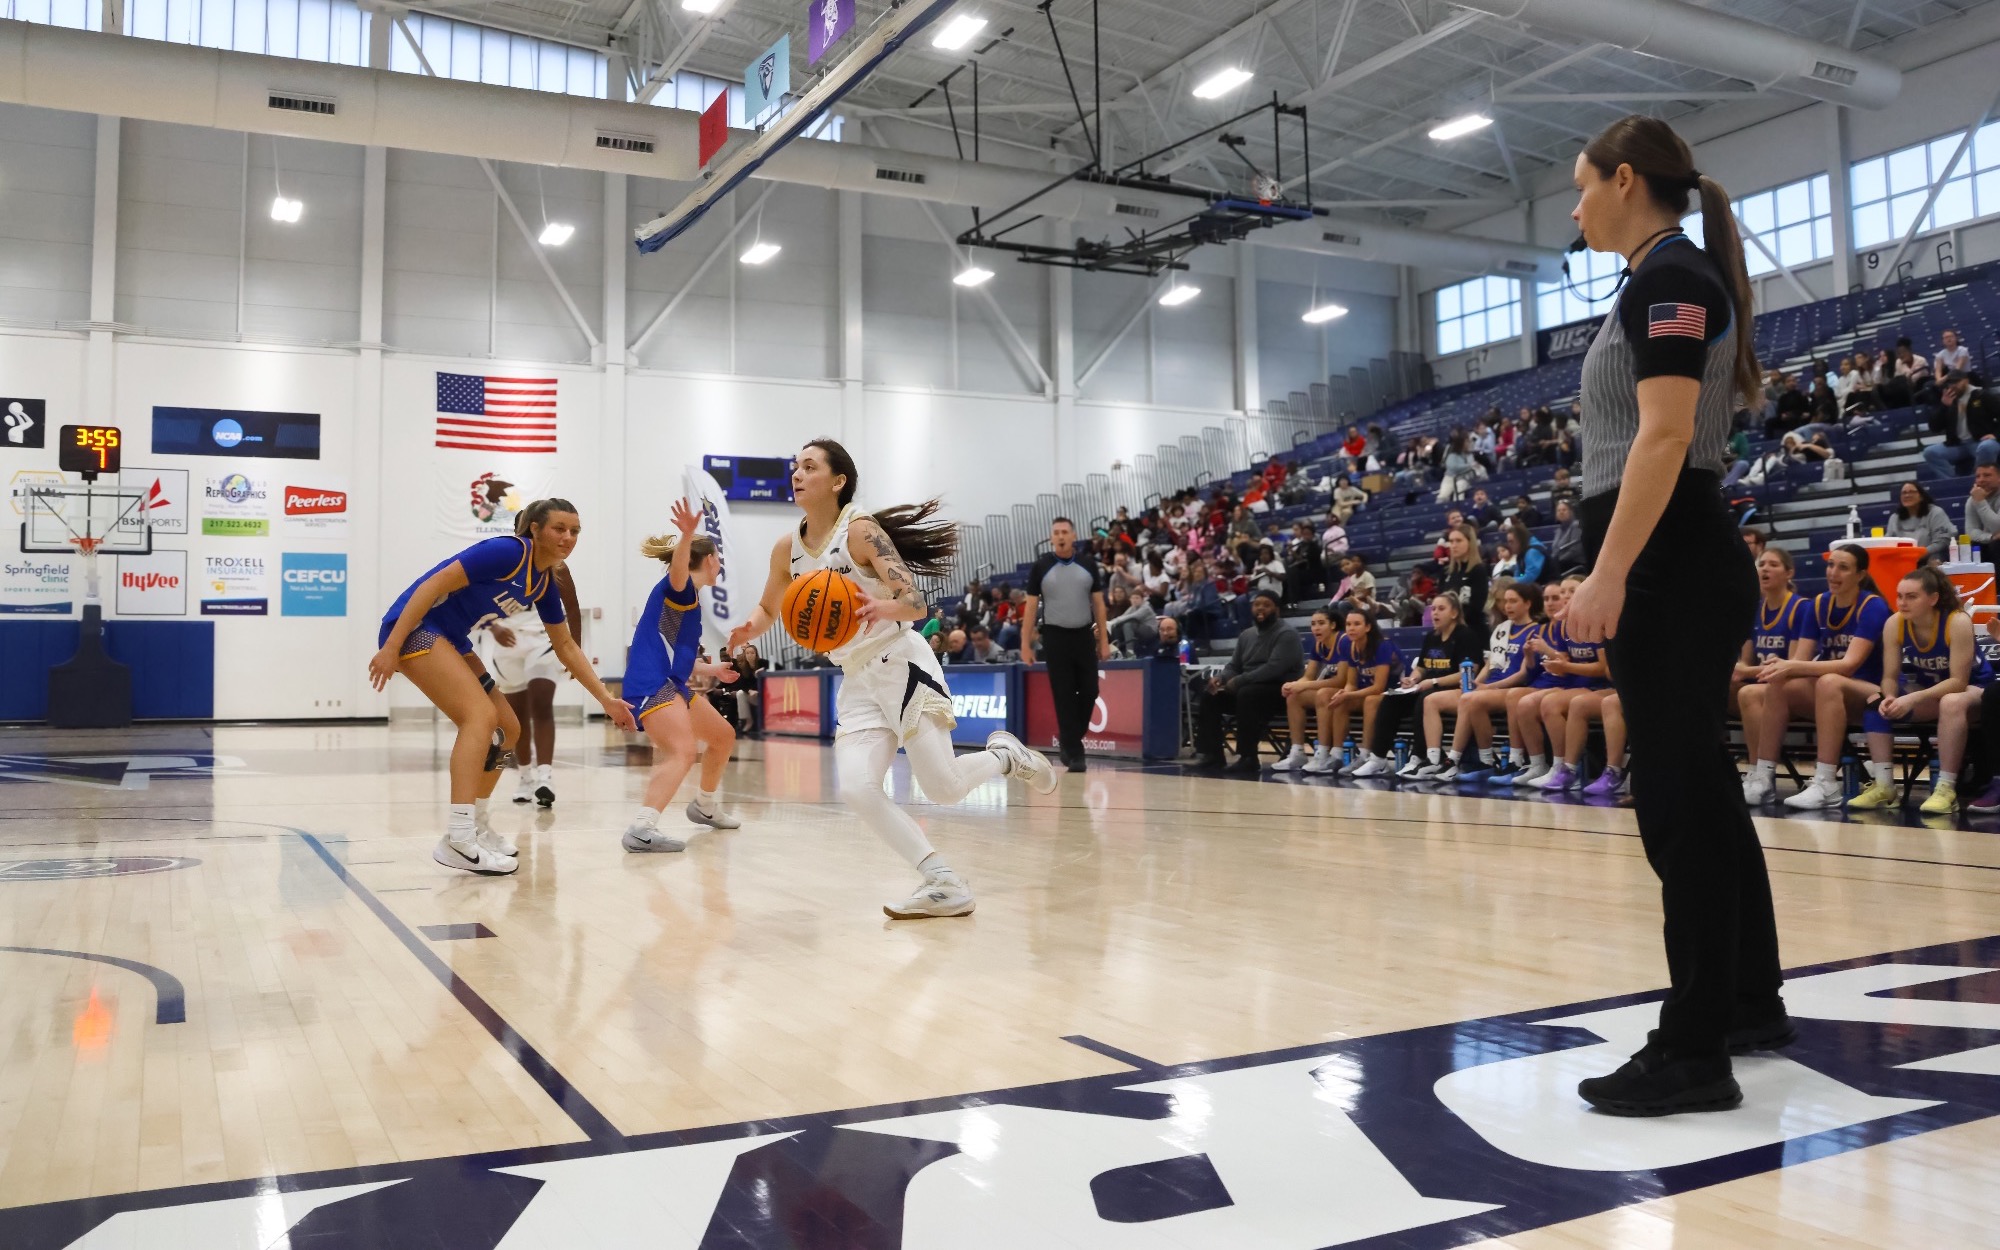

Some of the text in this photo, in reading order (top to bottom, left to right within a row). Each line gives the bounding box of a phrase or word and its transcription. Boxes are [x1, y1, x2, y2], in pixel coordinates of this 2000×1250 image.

[1867, 252, 1879, 269] 9
[76, 428, 118, 447] 3:55
[91, 446, 106, 469] 7
[286, 493, 344, 508] Peerless
[122, 517, 182, 527] BSN PORTS
[204, 556, 265, 568] TROXELL
[4, 563, 70, 577] Springfield
[205, 566, 265, 575] INSURANCE
[283, 568, 346, 584] CEFCU
[40, 574, 69, 583] clinic
[796, 587, 821, 641] Wilson
[823, 600, 843, 641] NCAA
[1756, 635, 1786, 649] AKERS
